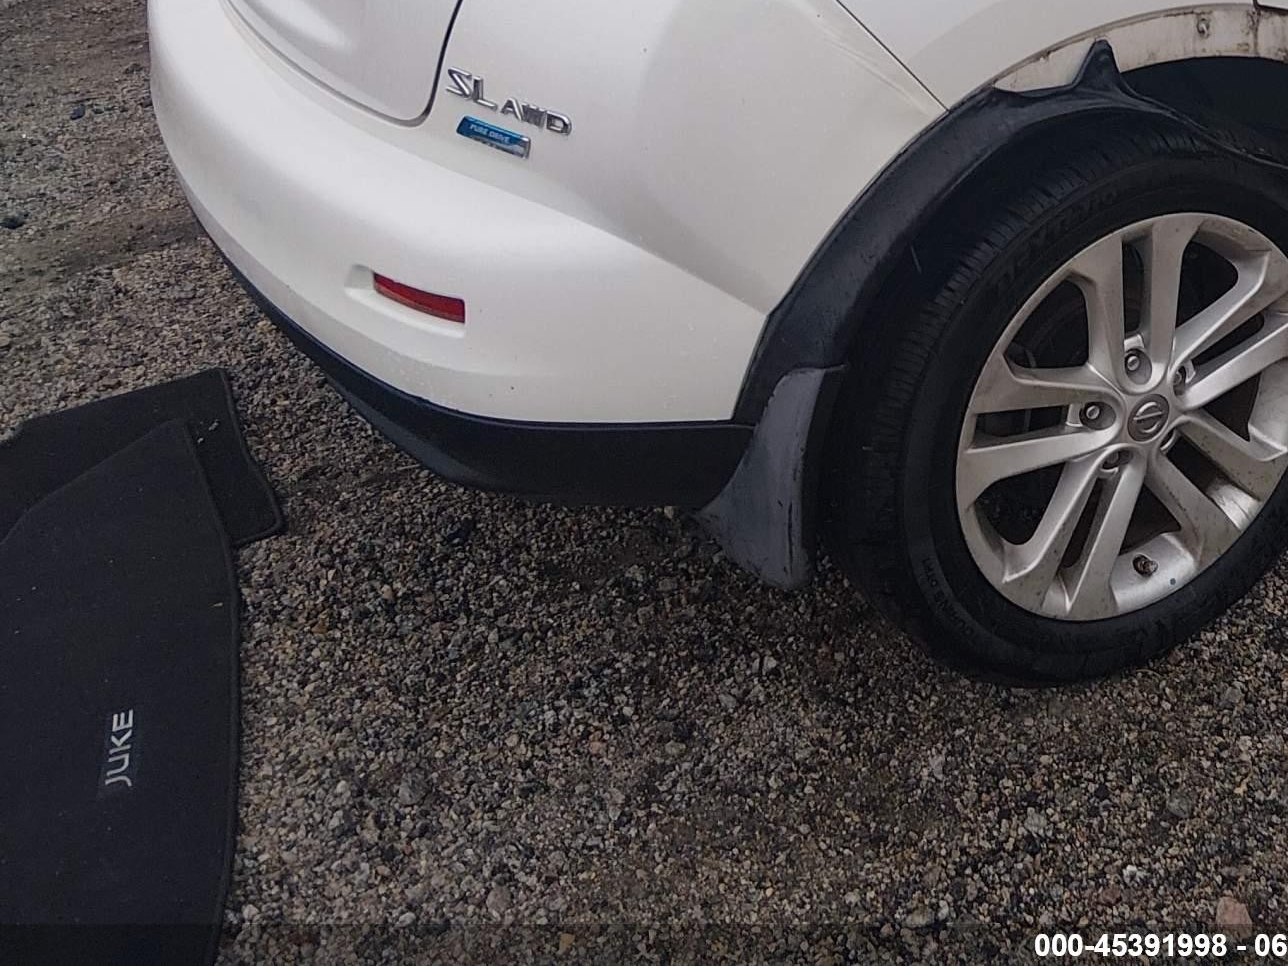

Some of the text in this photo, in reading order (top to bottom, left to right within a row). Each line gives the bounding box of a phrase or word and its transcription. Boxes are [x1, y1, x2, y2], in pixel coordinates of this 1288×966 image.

[445, 66, 573, 136] SL AWD
[470, 123, 511, 144] PURE DRIVE
[104, 709, 133, 787] JUKE
